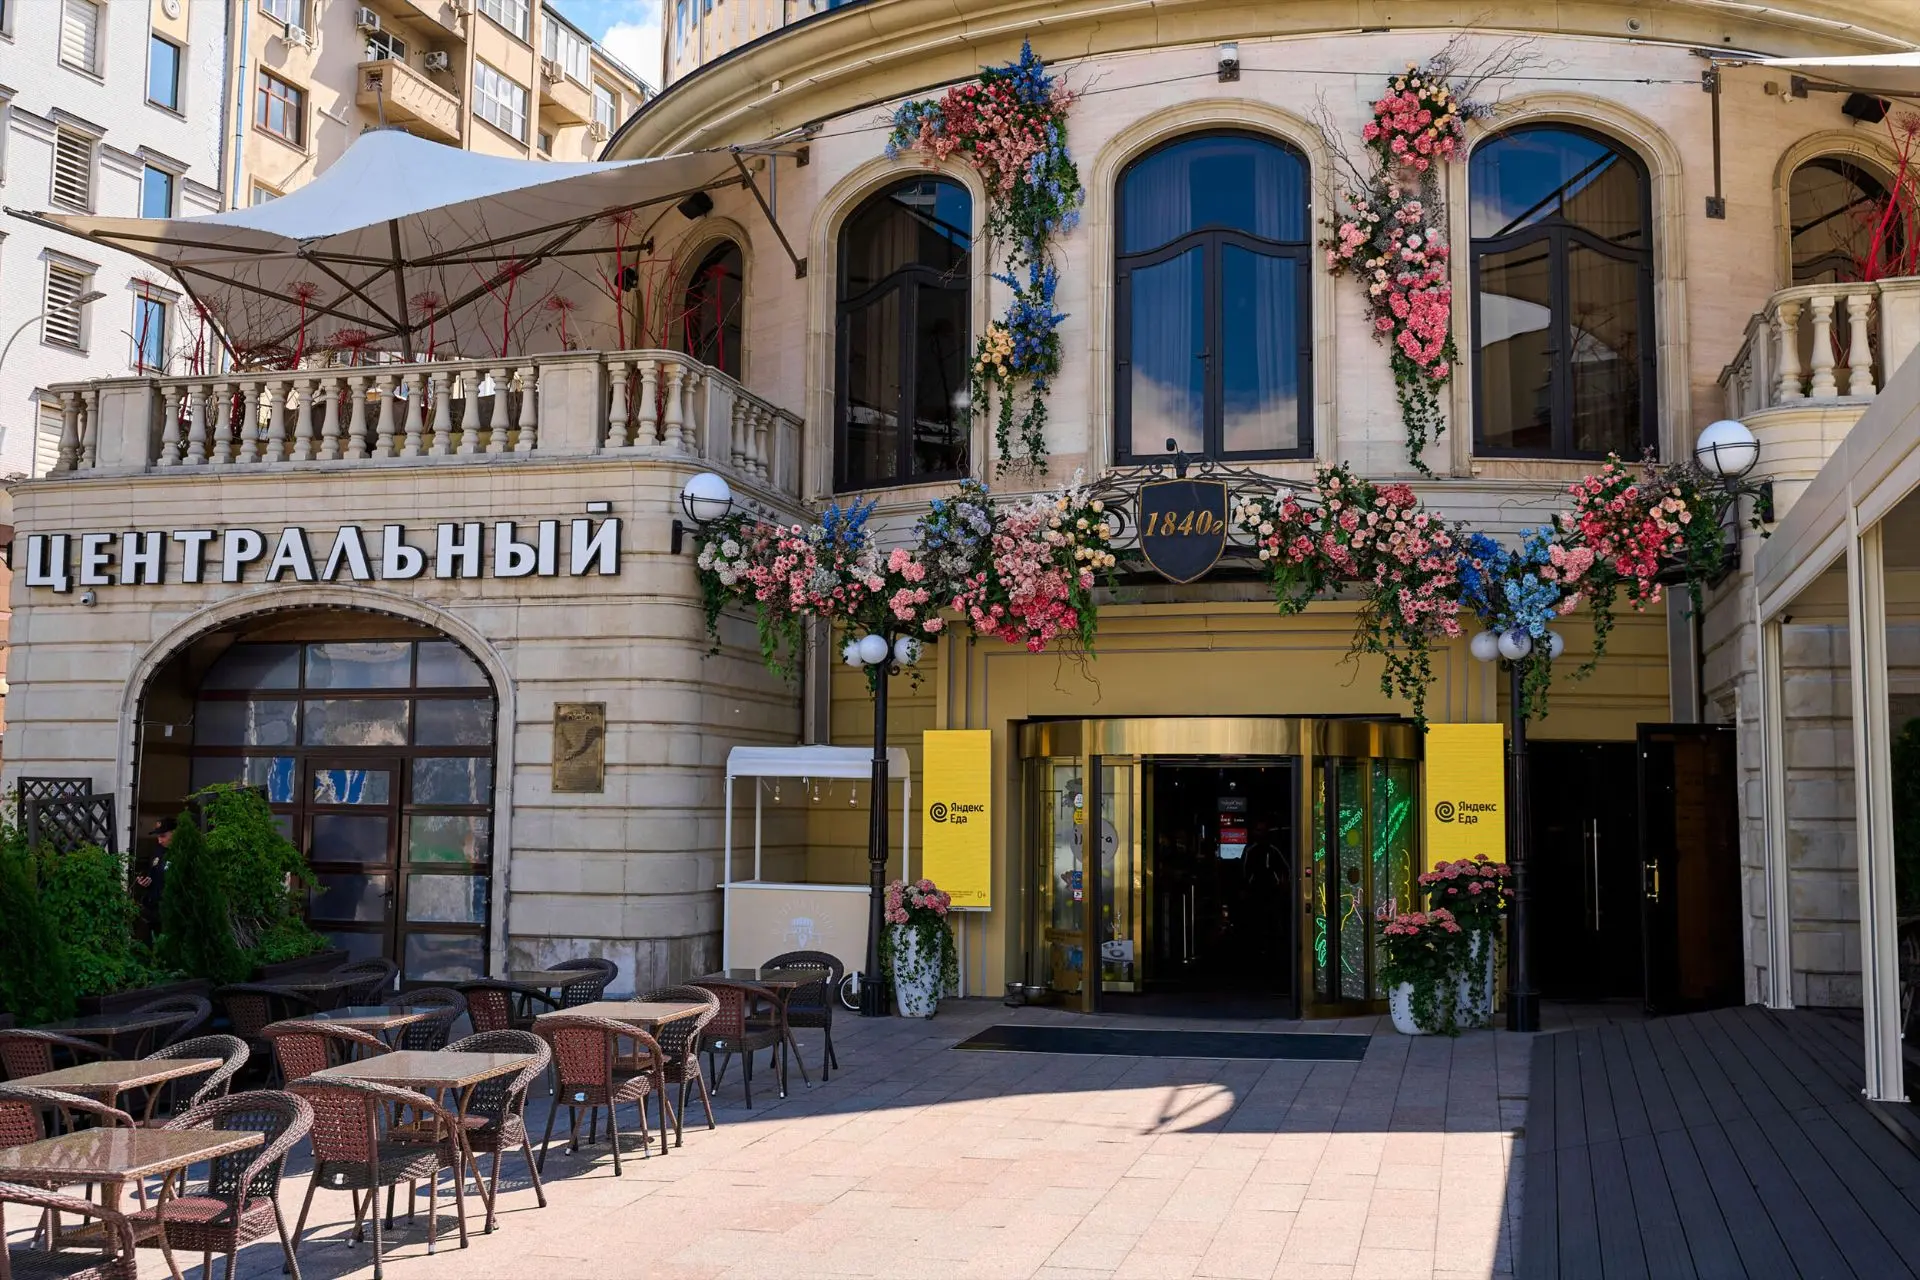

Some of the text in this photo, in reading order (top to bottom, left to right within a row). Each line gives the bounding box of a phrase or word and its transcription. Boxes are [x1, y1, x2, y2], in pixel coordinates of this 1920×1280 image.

[26, 501, 622, 594] ЦЕНТРАЛЬНЫЙ
[950, 802, 985, 813] Яндекс
[1458, 801, 1497, 812] Яндекс
[950, 813, 968, 825] Еда
[1458, 812, 1478, 825] Еда
